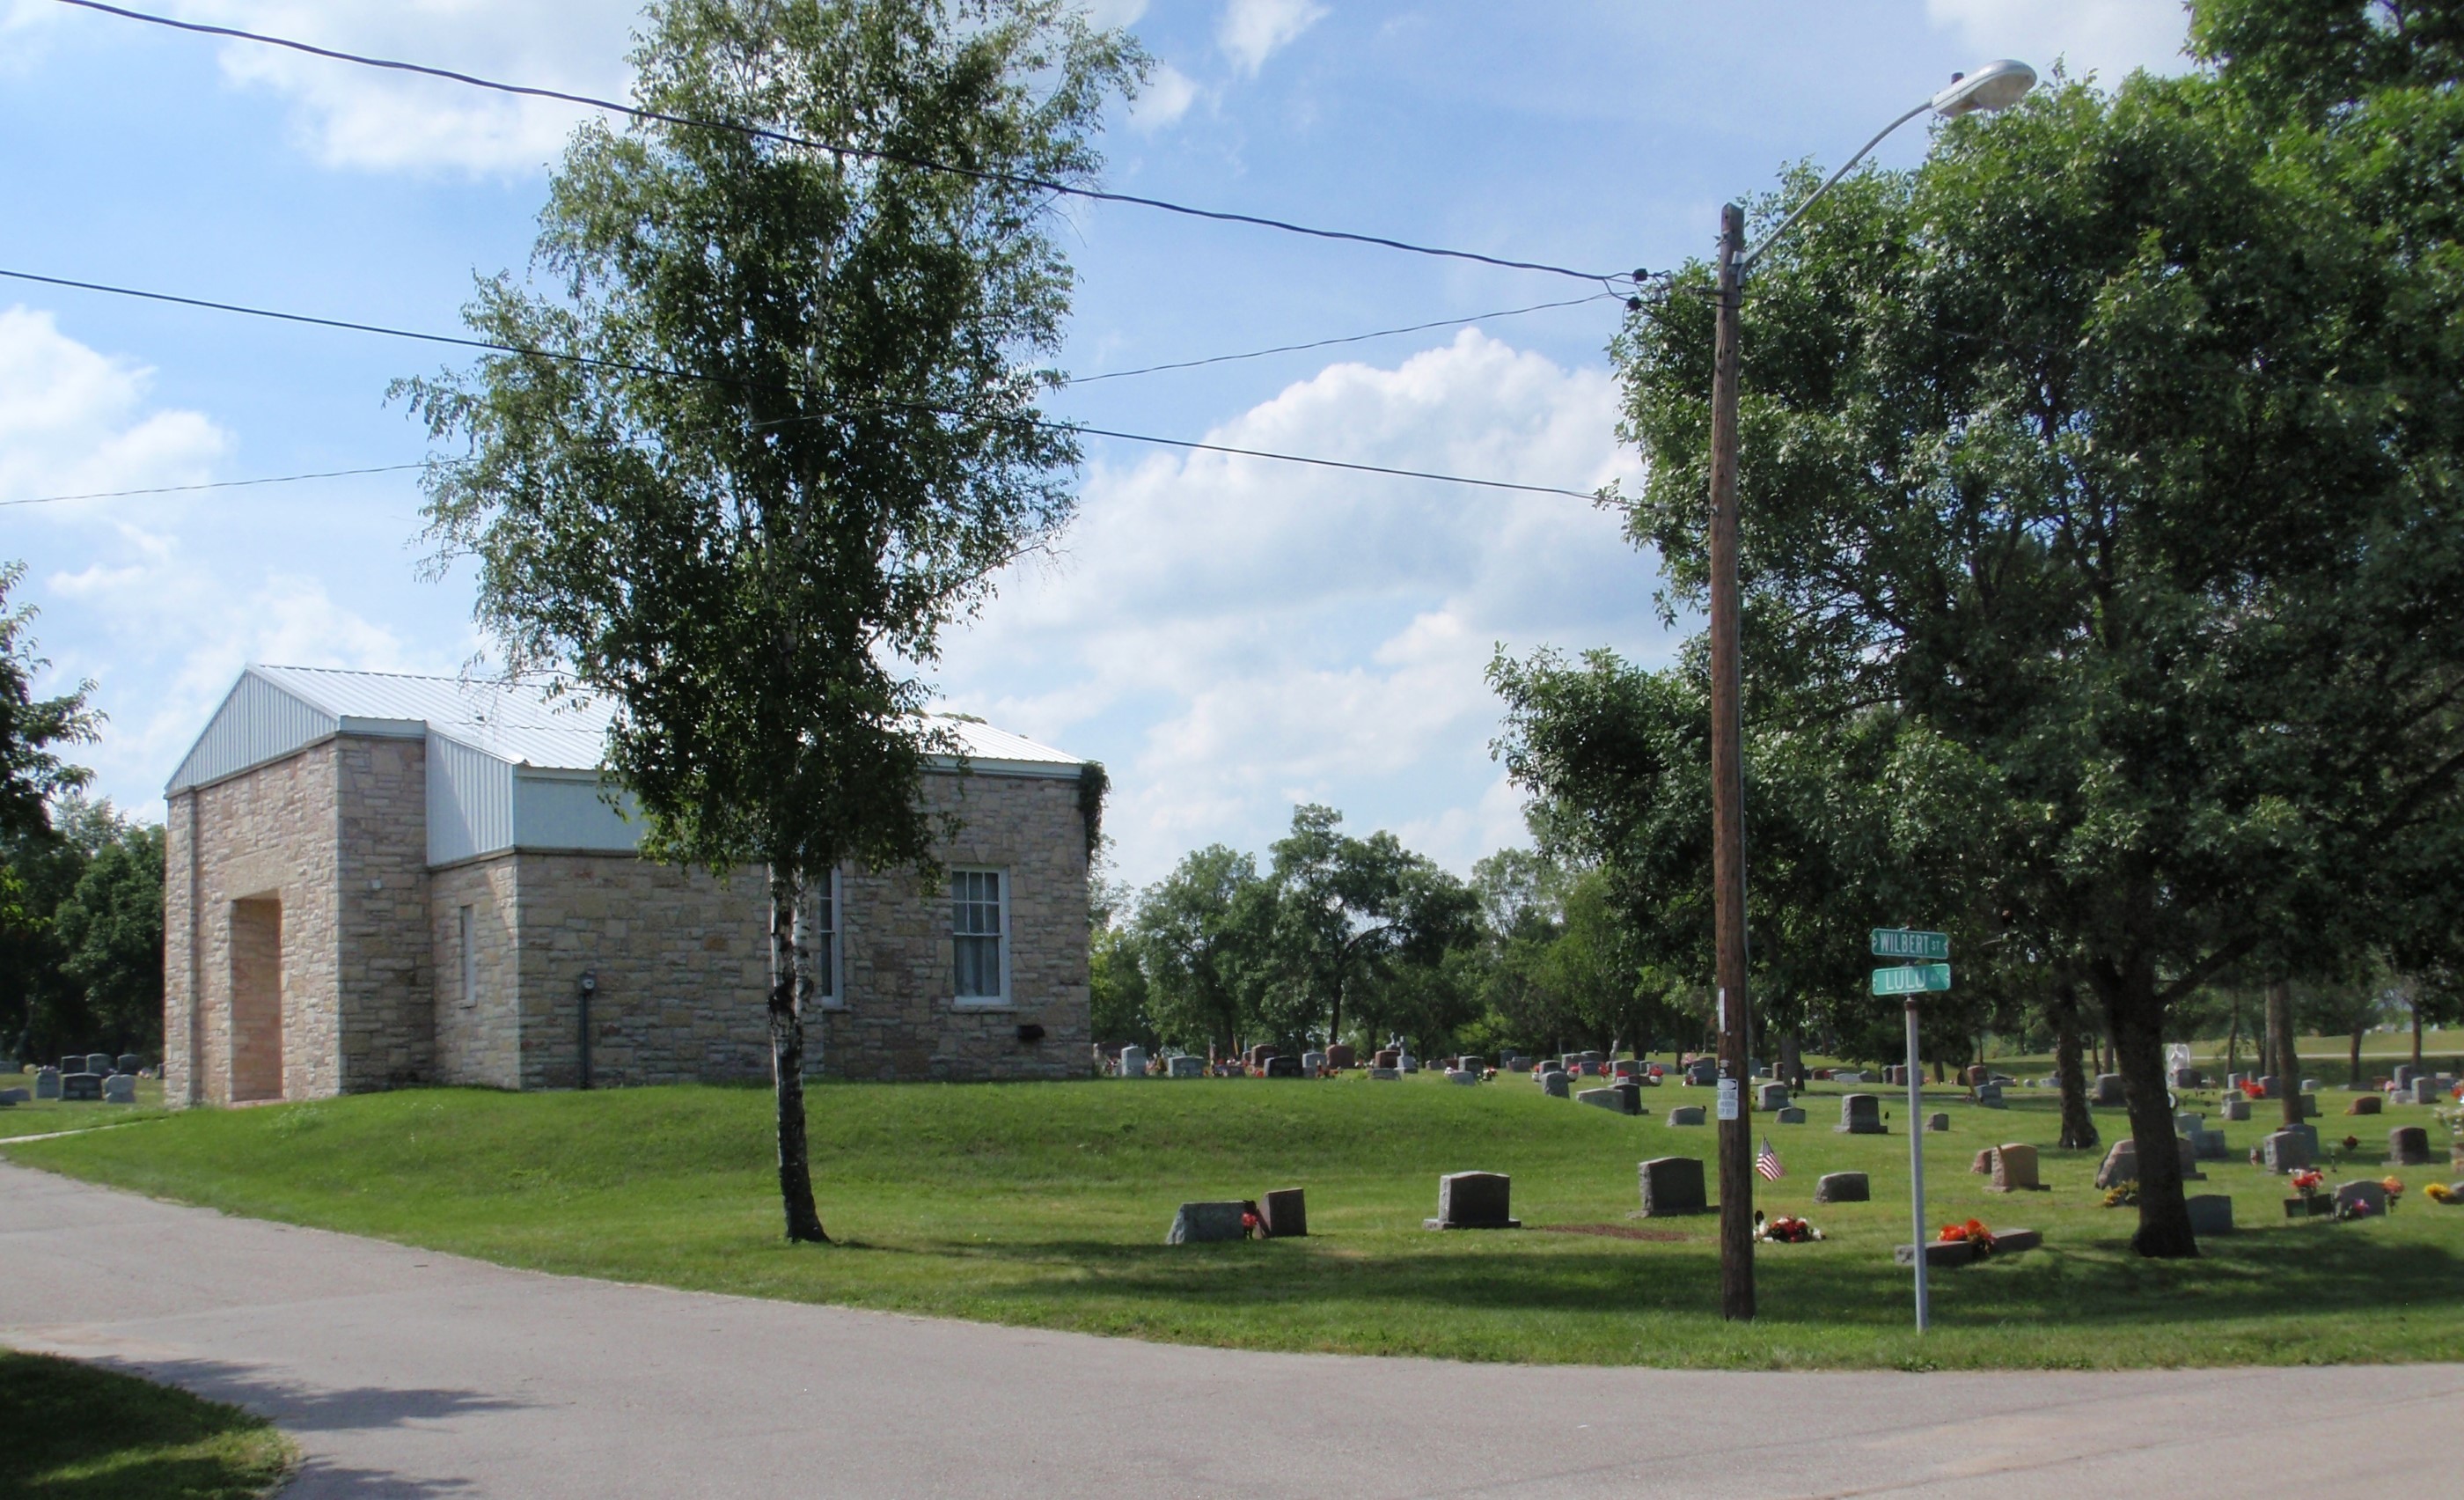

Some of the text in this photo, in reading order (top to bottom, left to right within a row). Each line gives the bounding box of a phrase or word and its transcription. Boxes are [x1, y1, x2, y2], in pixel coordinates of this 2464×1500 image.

[1880, 933, 1940, 954] WILBERT ST
[1886, 969, 1926, 990] LULU
